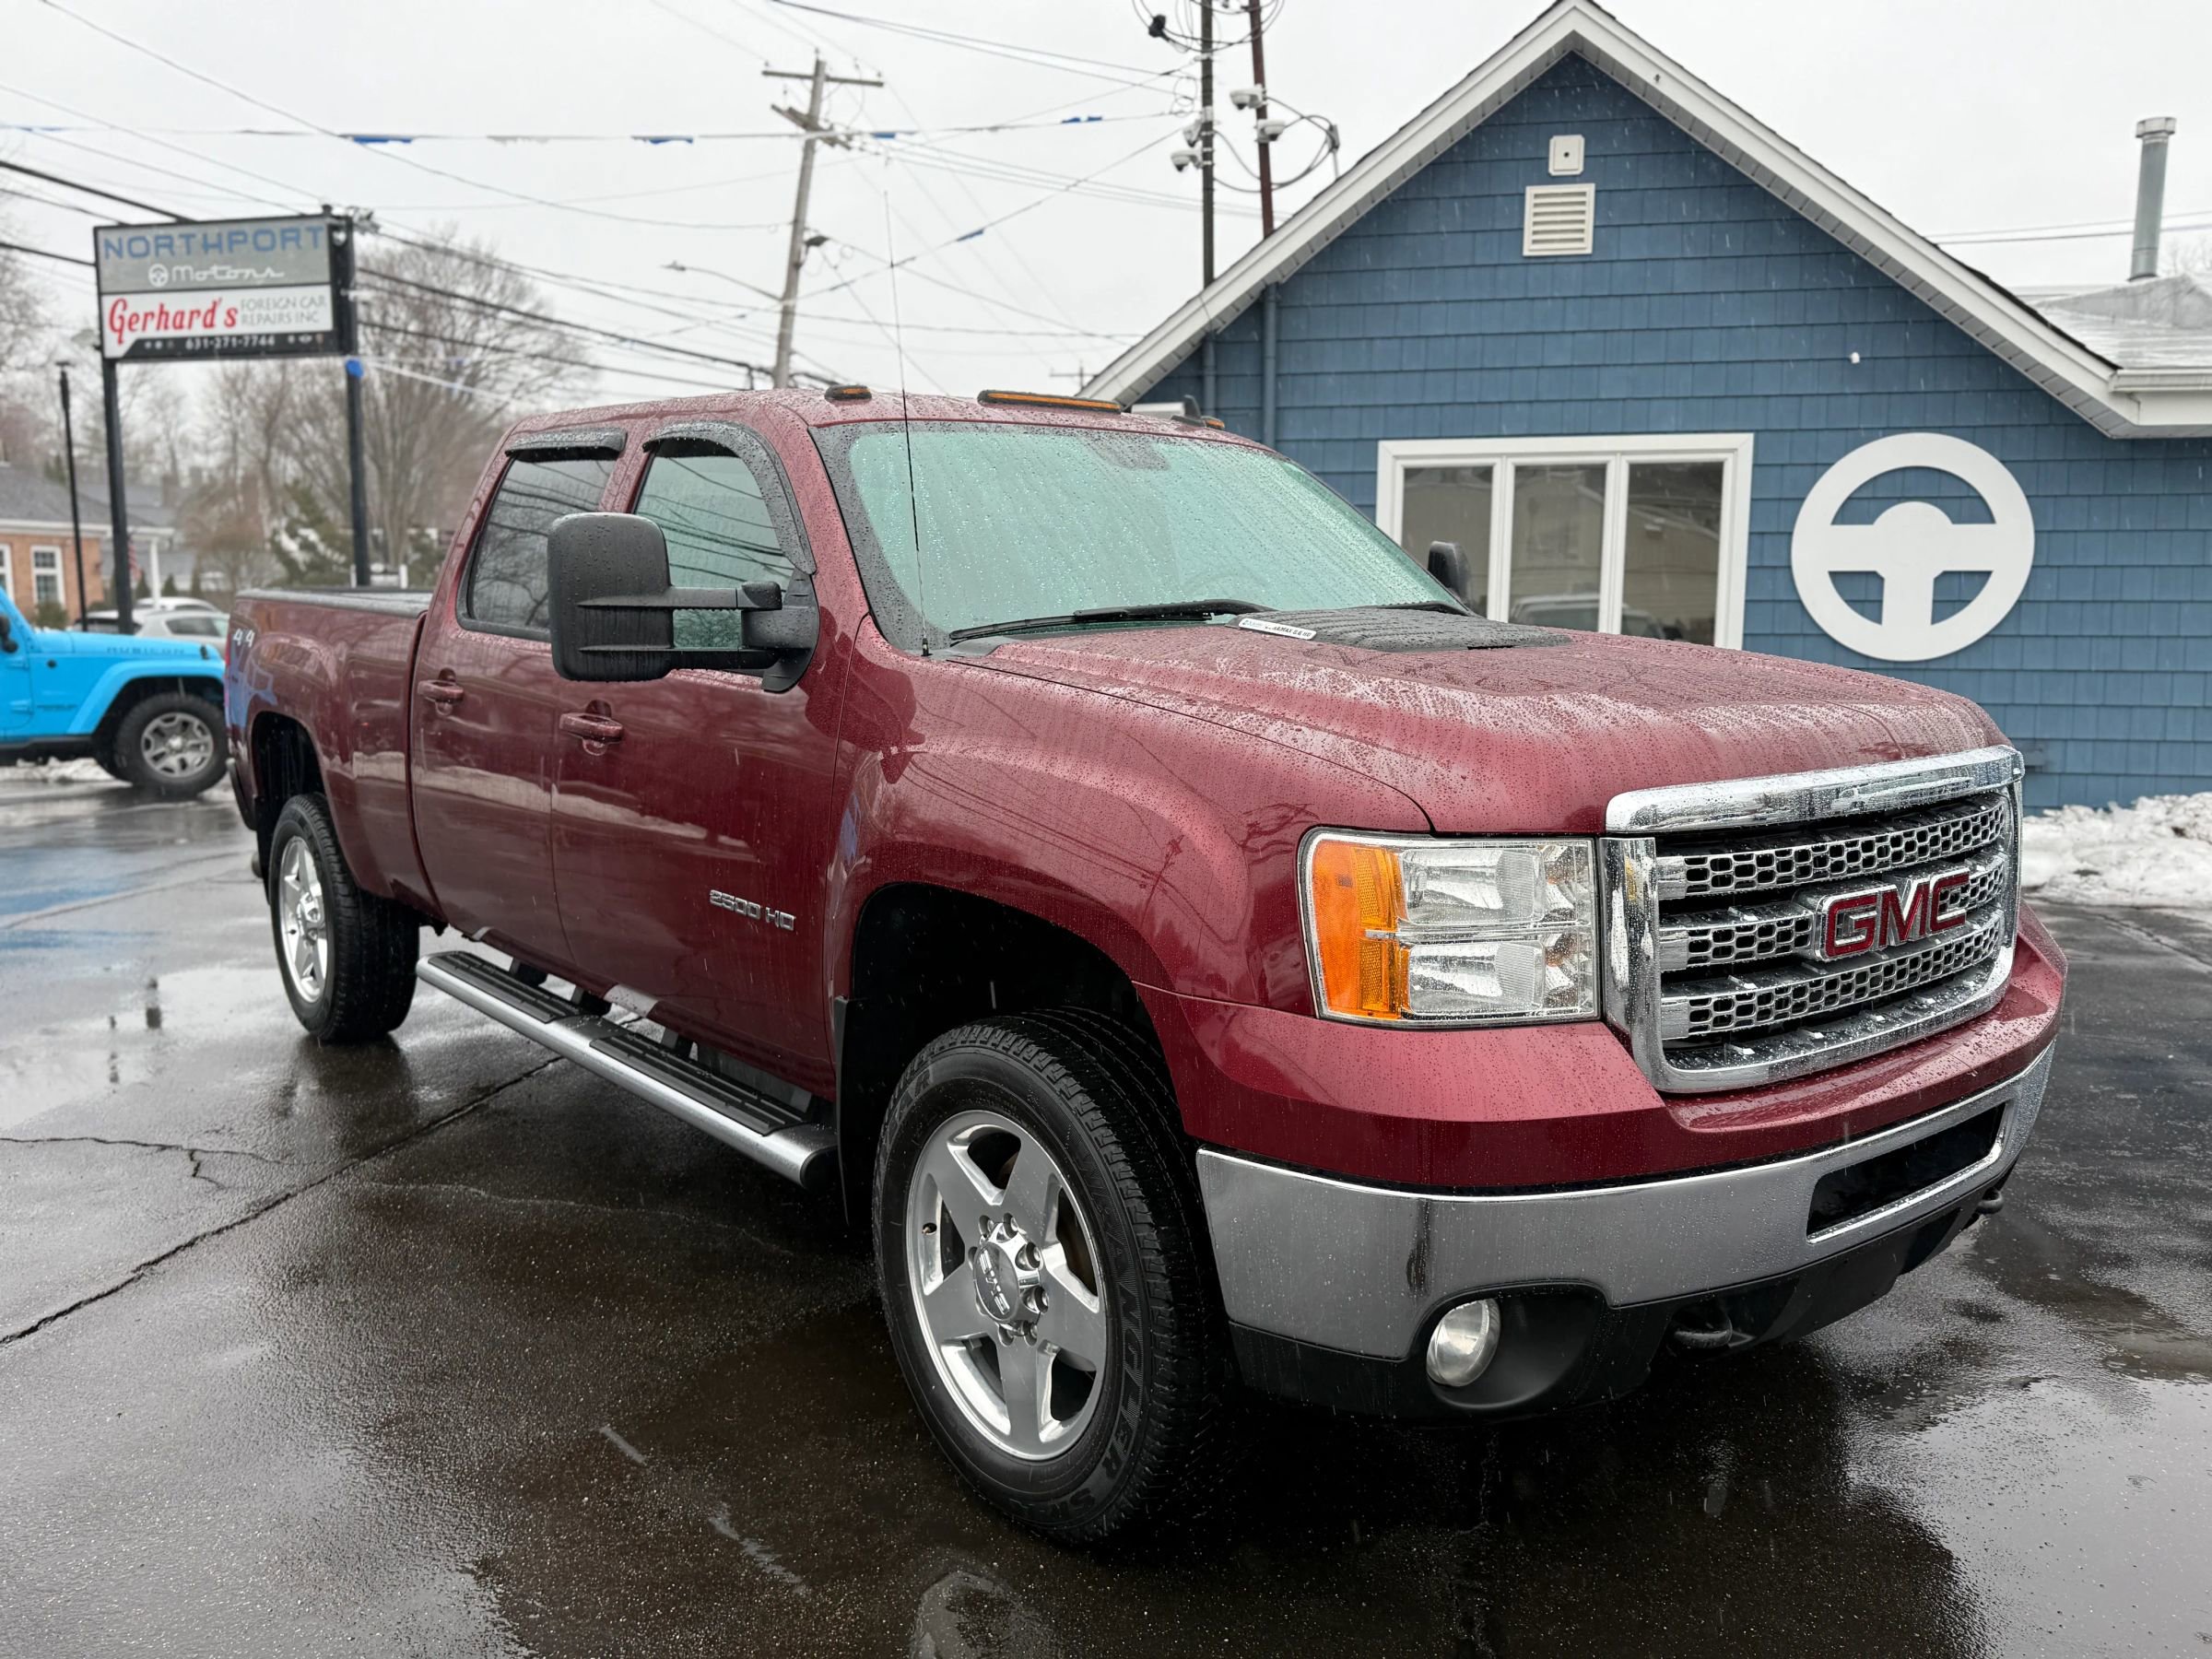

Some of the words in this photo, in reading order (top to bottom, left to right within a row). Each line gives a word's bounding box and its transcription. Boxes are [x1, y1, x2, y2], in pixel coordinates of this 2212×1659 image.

[103, 226, 323, 260] NORTHPORT
[172, 264, 285, 282] Motors
[241, 296, 297, 311] FOREIGN
[300, 295, 325, 309] CAR
[109, 298, 238, 346] Gerhard's
[241, 312, 291, 325] REPAIRS
[185, 337, 275, 350] 631-271-7744
[232, 628, 255, 648] 44
[710, 889, 761, 920] 2500
[765, 907, 796, 931] HD
[1822, 867, 1970, 960] GMC
